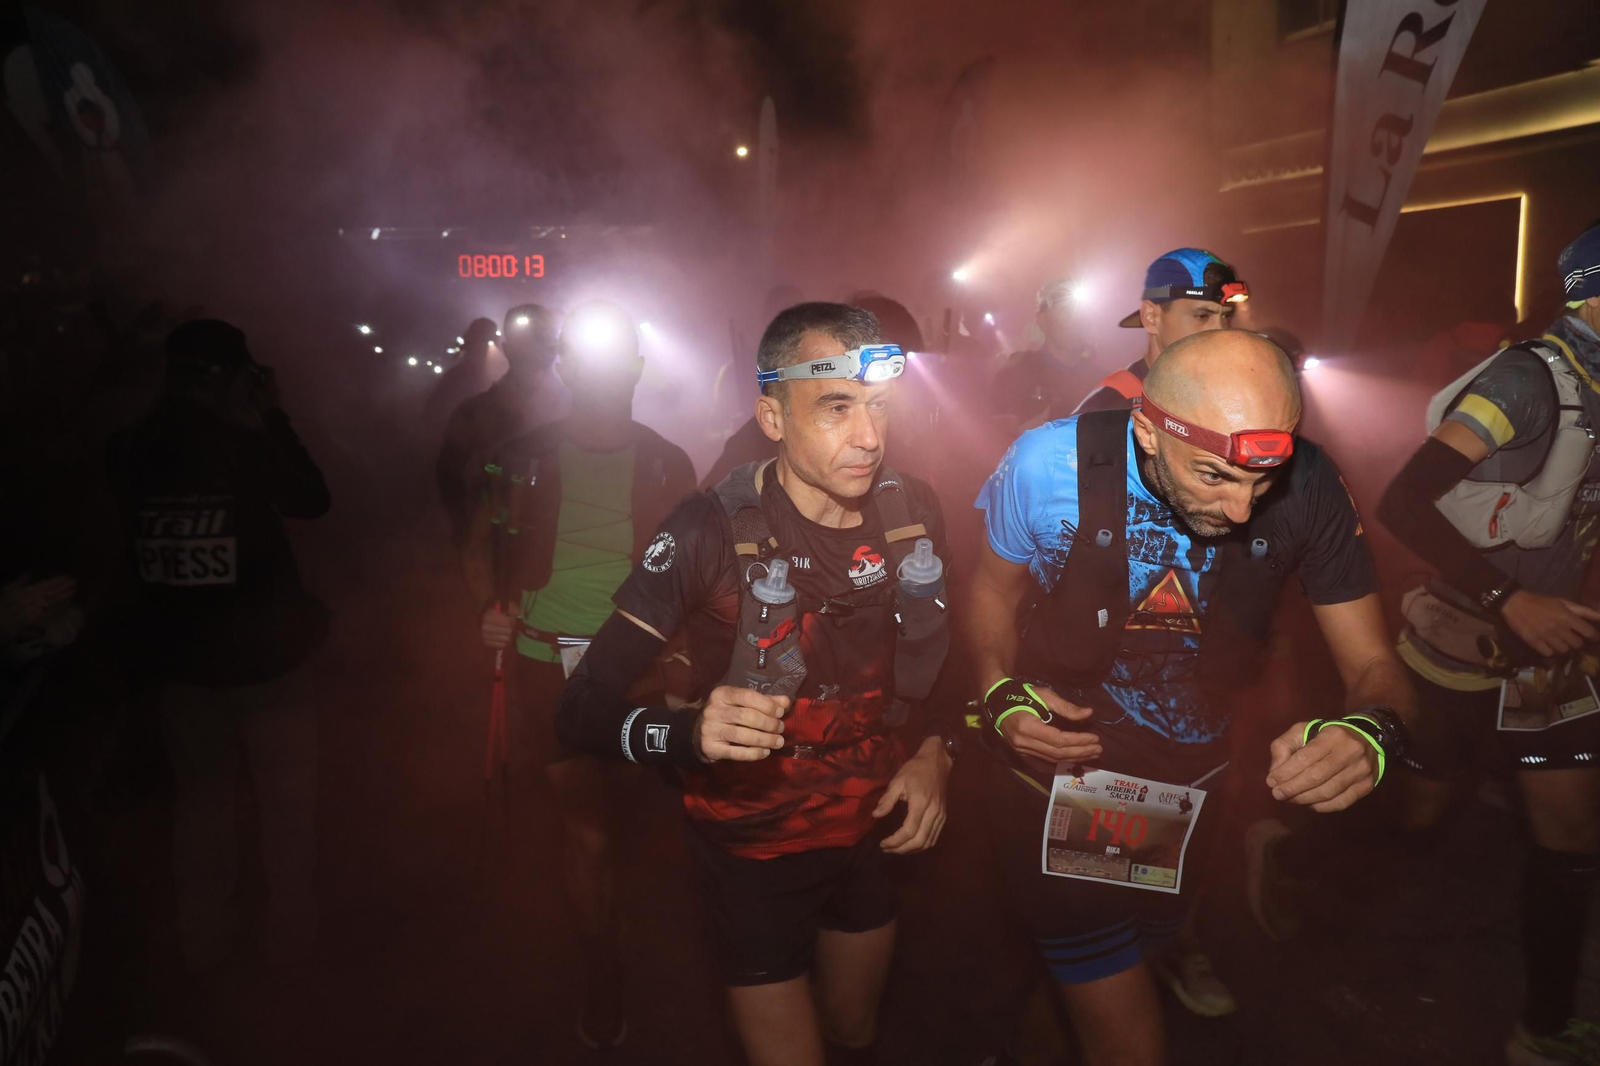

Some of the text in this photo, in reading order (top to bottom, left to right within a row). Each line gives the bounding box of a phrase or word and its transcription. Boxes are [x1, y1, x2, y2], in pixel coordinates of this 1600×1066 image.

[1378, 0, 1457, 94] R
[811, 362, 836, 375] PETZL
[1165, 418, 1190, 437] PETZL
[141, 544, 230, 579] PRESS
[1006, 693, 1033, 705] LEKI
[1105, 784, 1137, 795] RIBEIRA
[1114, 779, 1140, 789] TRAIL
[1109, 792, 1135, 802] SACRA
[1086, 808, 1149, 847] 140
[0, 896, 64, 1064] BEIRA
